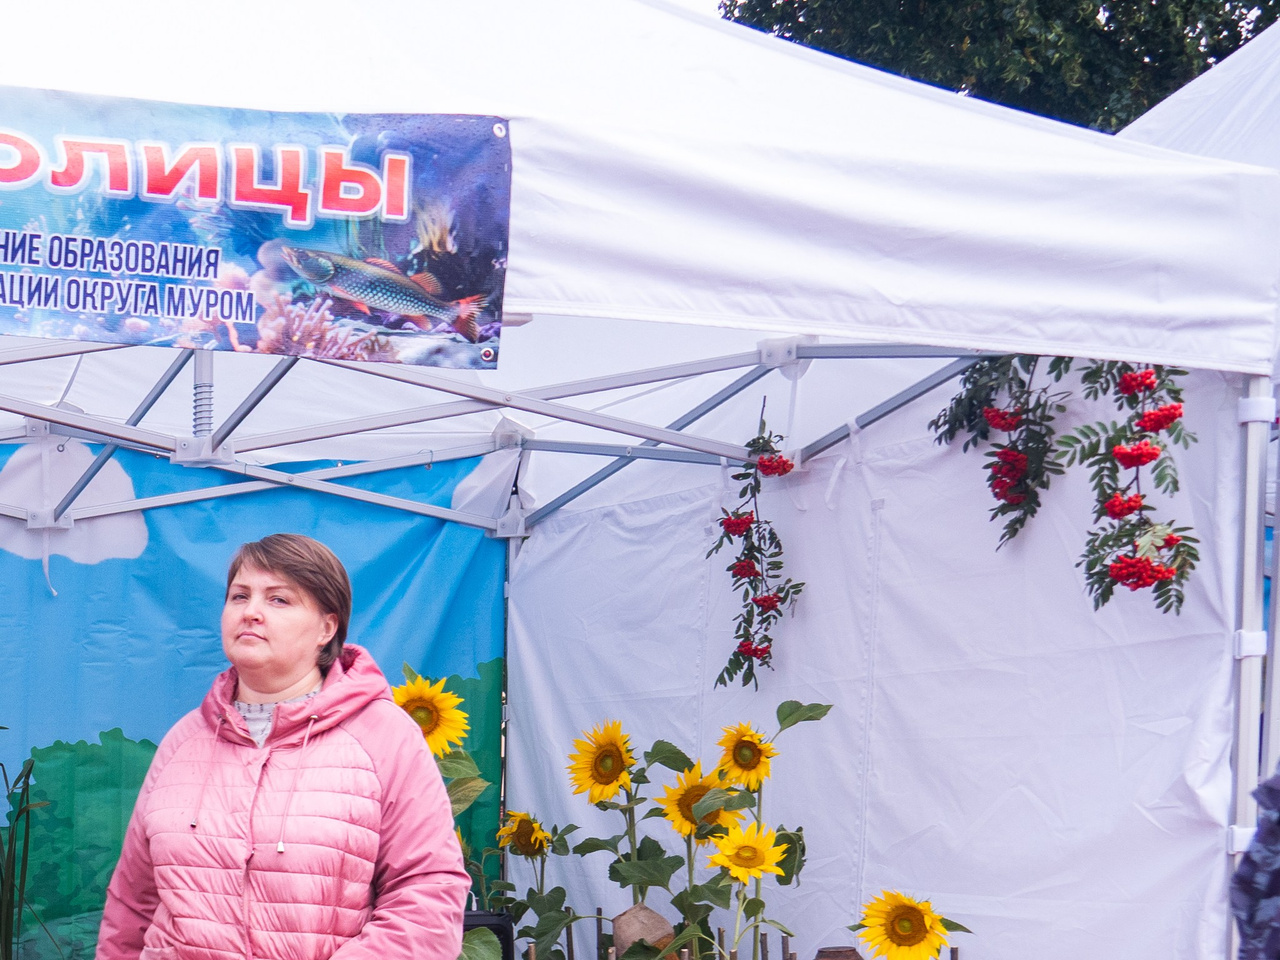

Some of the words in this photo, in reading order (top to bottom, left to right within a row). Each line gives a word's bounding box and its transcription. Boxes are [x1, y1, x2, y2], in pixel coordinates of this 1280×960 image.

[48, 235, 220, 279] ОБРАЗОВАНИЯ
[68, 279, 159, 316] ОКРУГА
[165, 286, 256, 324] МУРОМ
